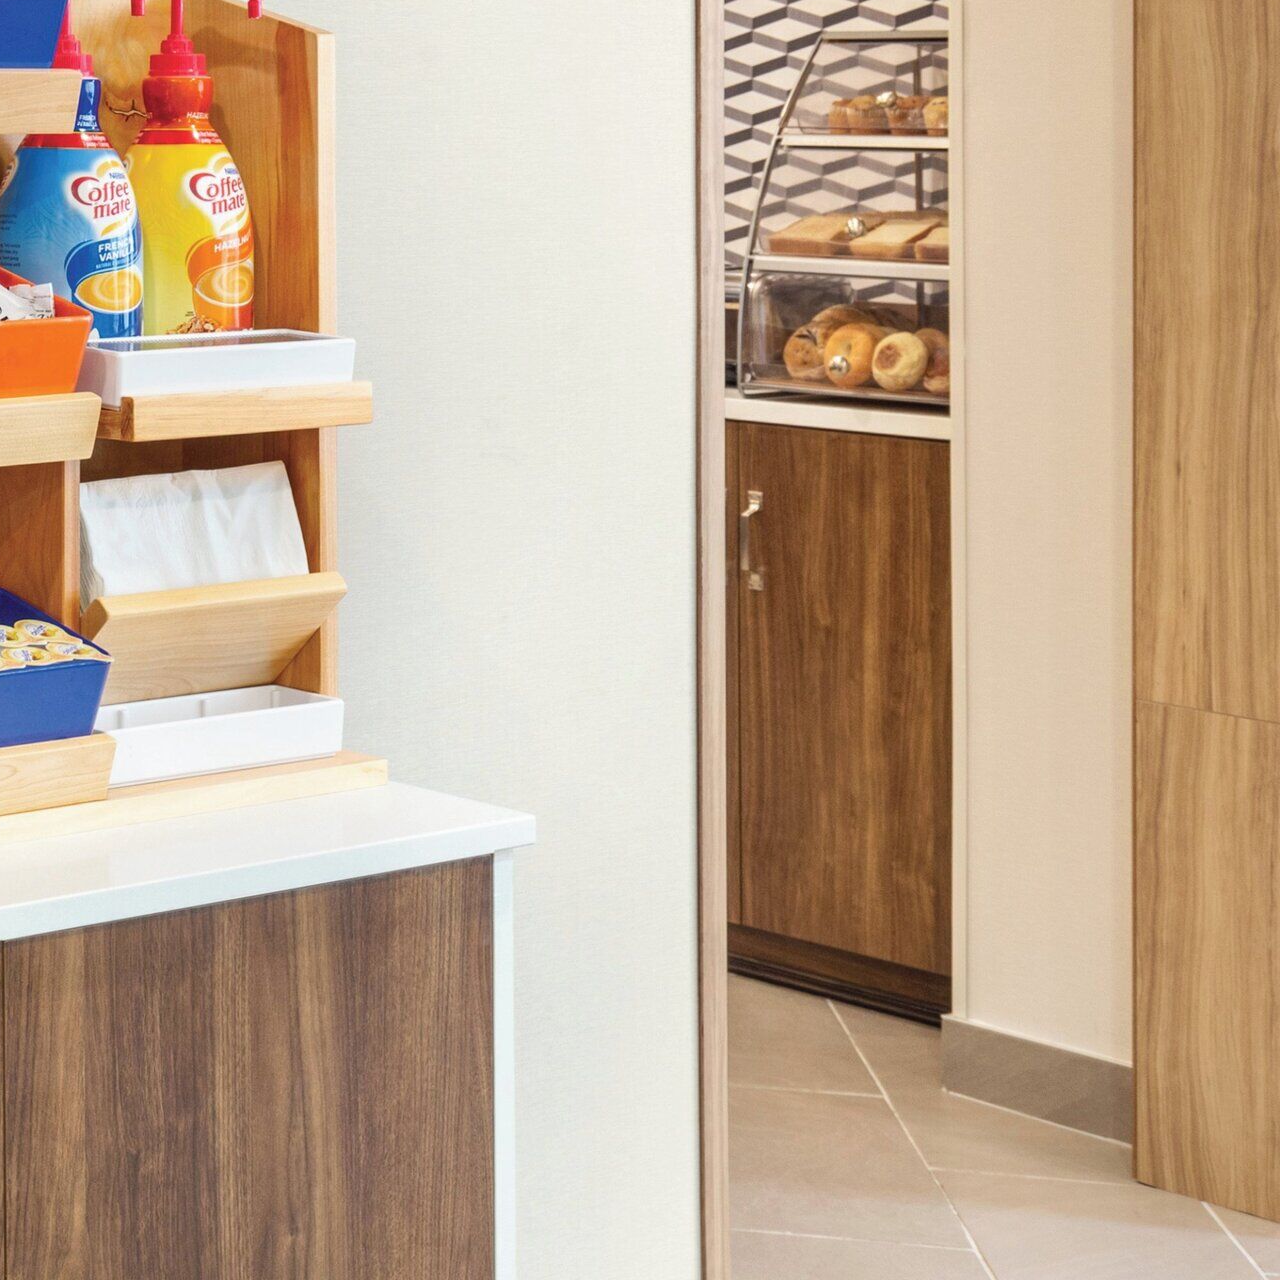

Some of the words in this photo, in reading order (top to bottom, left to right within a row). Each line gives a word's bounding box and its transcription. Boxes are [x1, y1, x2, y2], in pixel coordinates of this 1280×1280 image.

[71, 176, 130, 206] Coffee
[189, 172, 243, 202] Coffee
[93, 198, 131, 219] mate
[212, 193, 245, 215] mate
